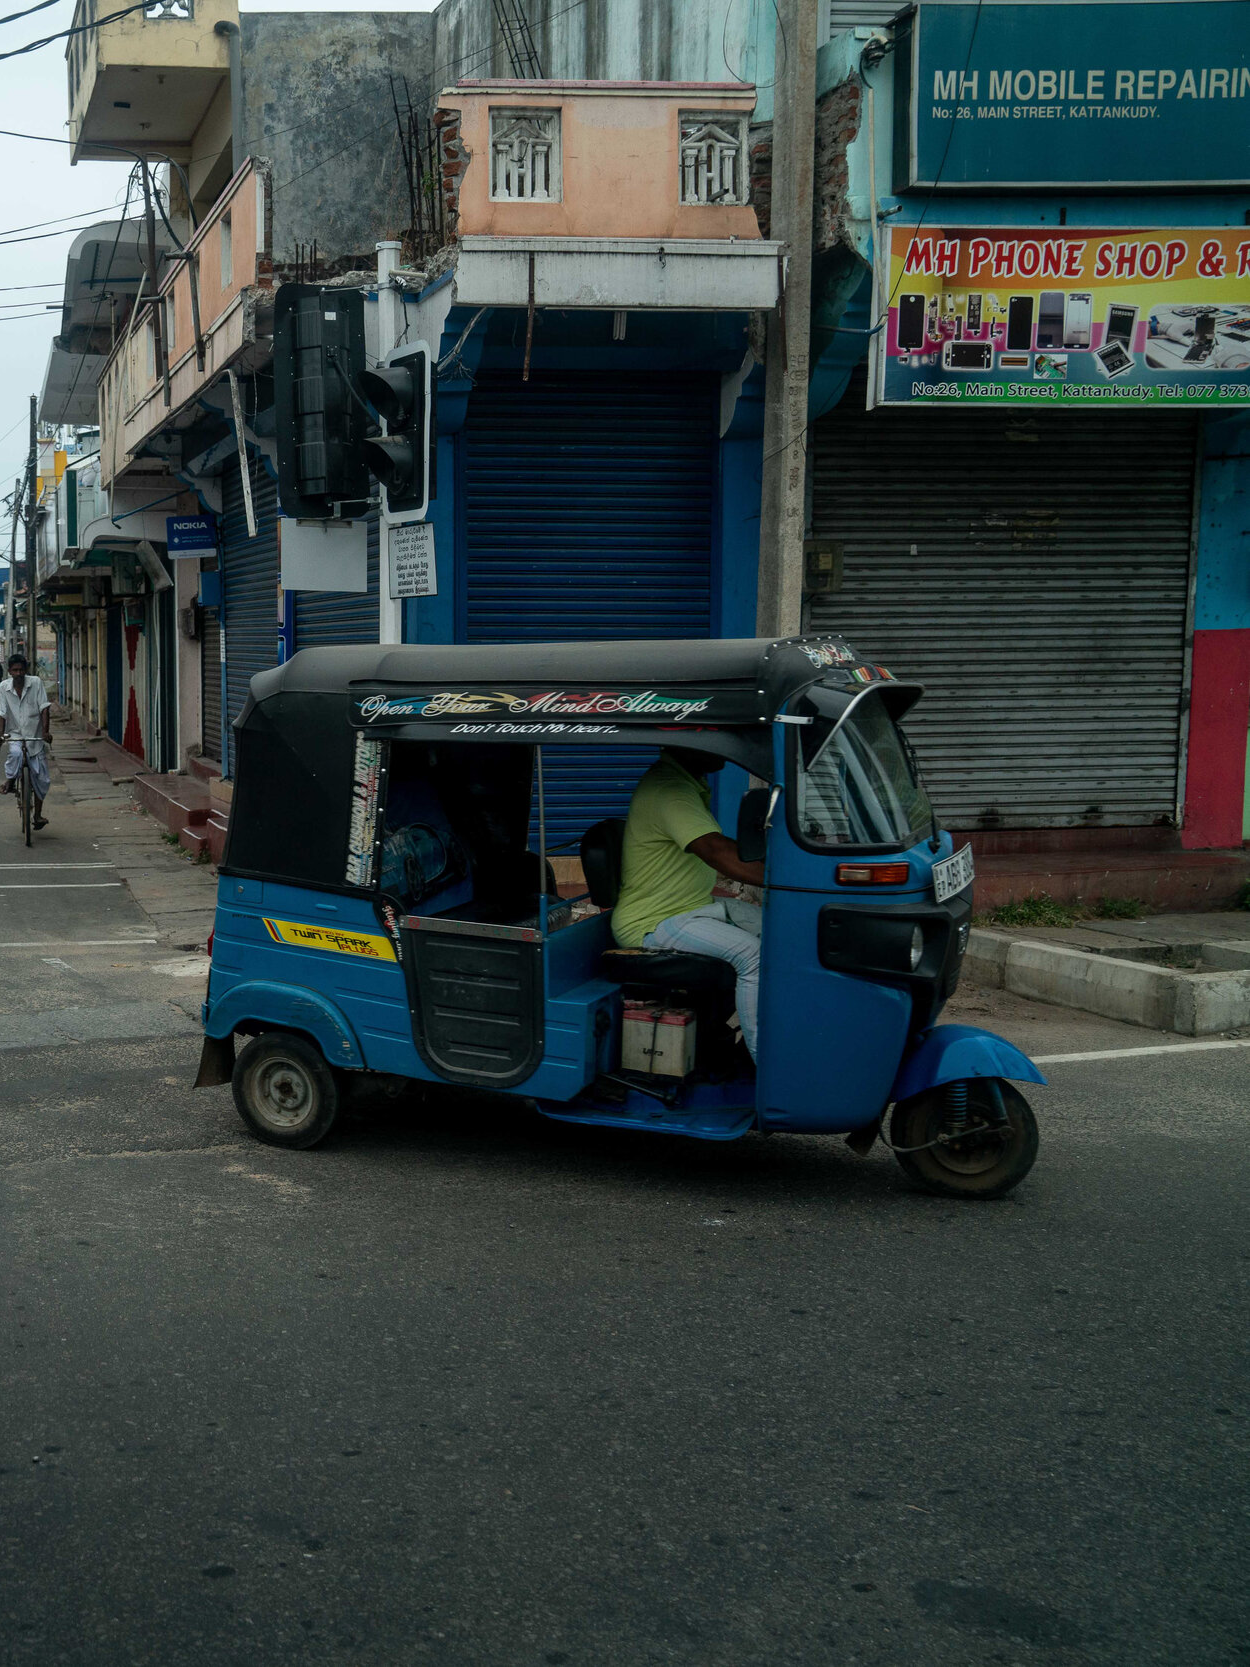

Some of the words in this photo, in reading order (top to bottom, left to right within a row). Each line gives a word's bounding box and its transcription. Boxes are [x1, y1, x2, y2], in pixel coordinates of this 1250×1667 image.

[933, 69, 979, 101] MH
[989, 69, 1105, 101] MOBILE
[932, 107, 953, 119] No:
[956, 107, 974, 121] 26,
[977, 106, 1009, 119] MAIN
[1012, 106, 1066, 121] STREET,
[1069, 105, 1161, 119] KATTANKUDY.
[903, 237, 960, 278] MH
[968, 237, 1087, 279] PHONE
[1094, 239, 1189, 280] SHOP
[1197, 239, 1227, 279] &
[911, 382, 961, 399] No:26,
[965, 383, 1006, 397] Main
[1009, 383, 1058, 399] Street,
[1062, 383, 1152, 402] Kattankudy.
[1156, 384, 1183, 398] Tel:
[1186, 385, 1216, 399] 077
[1219, 385, 1250, 399] 373
[173, 522, 207, 530] NOKIA
[359, 694, 416, 723] Open
[420, 691, 492, 718] Your
[508, 691, 600, 715] Mind
[596, 690, 714, 721] Always
[450, 723, 494, 734] Don't
[495, 723, 544, 734] Touch
[544, 723, 566, 734] My
[290, 928, 322, 940] TWIN
[326, 935, 372, 949] SPARK
[341, 944, 379, 956] PLUGS
